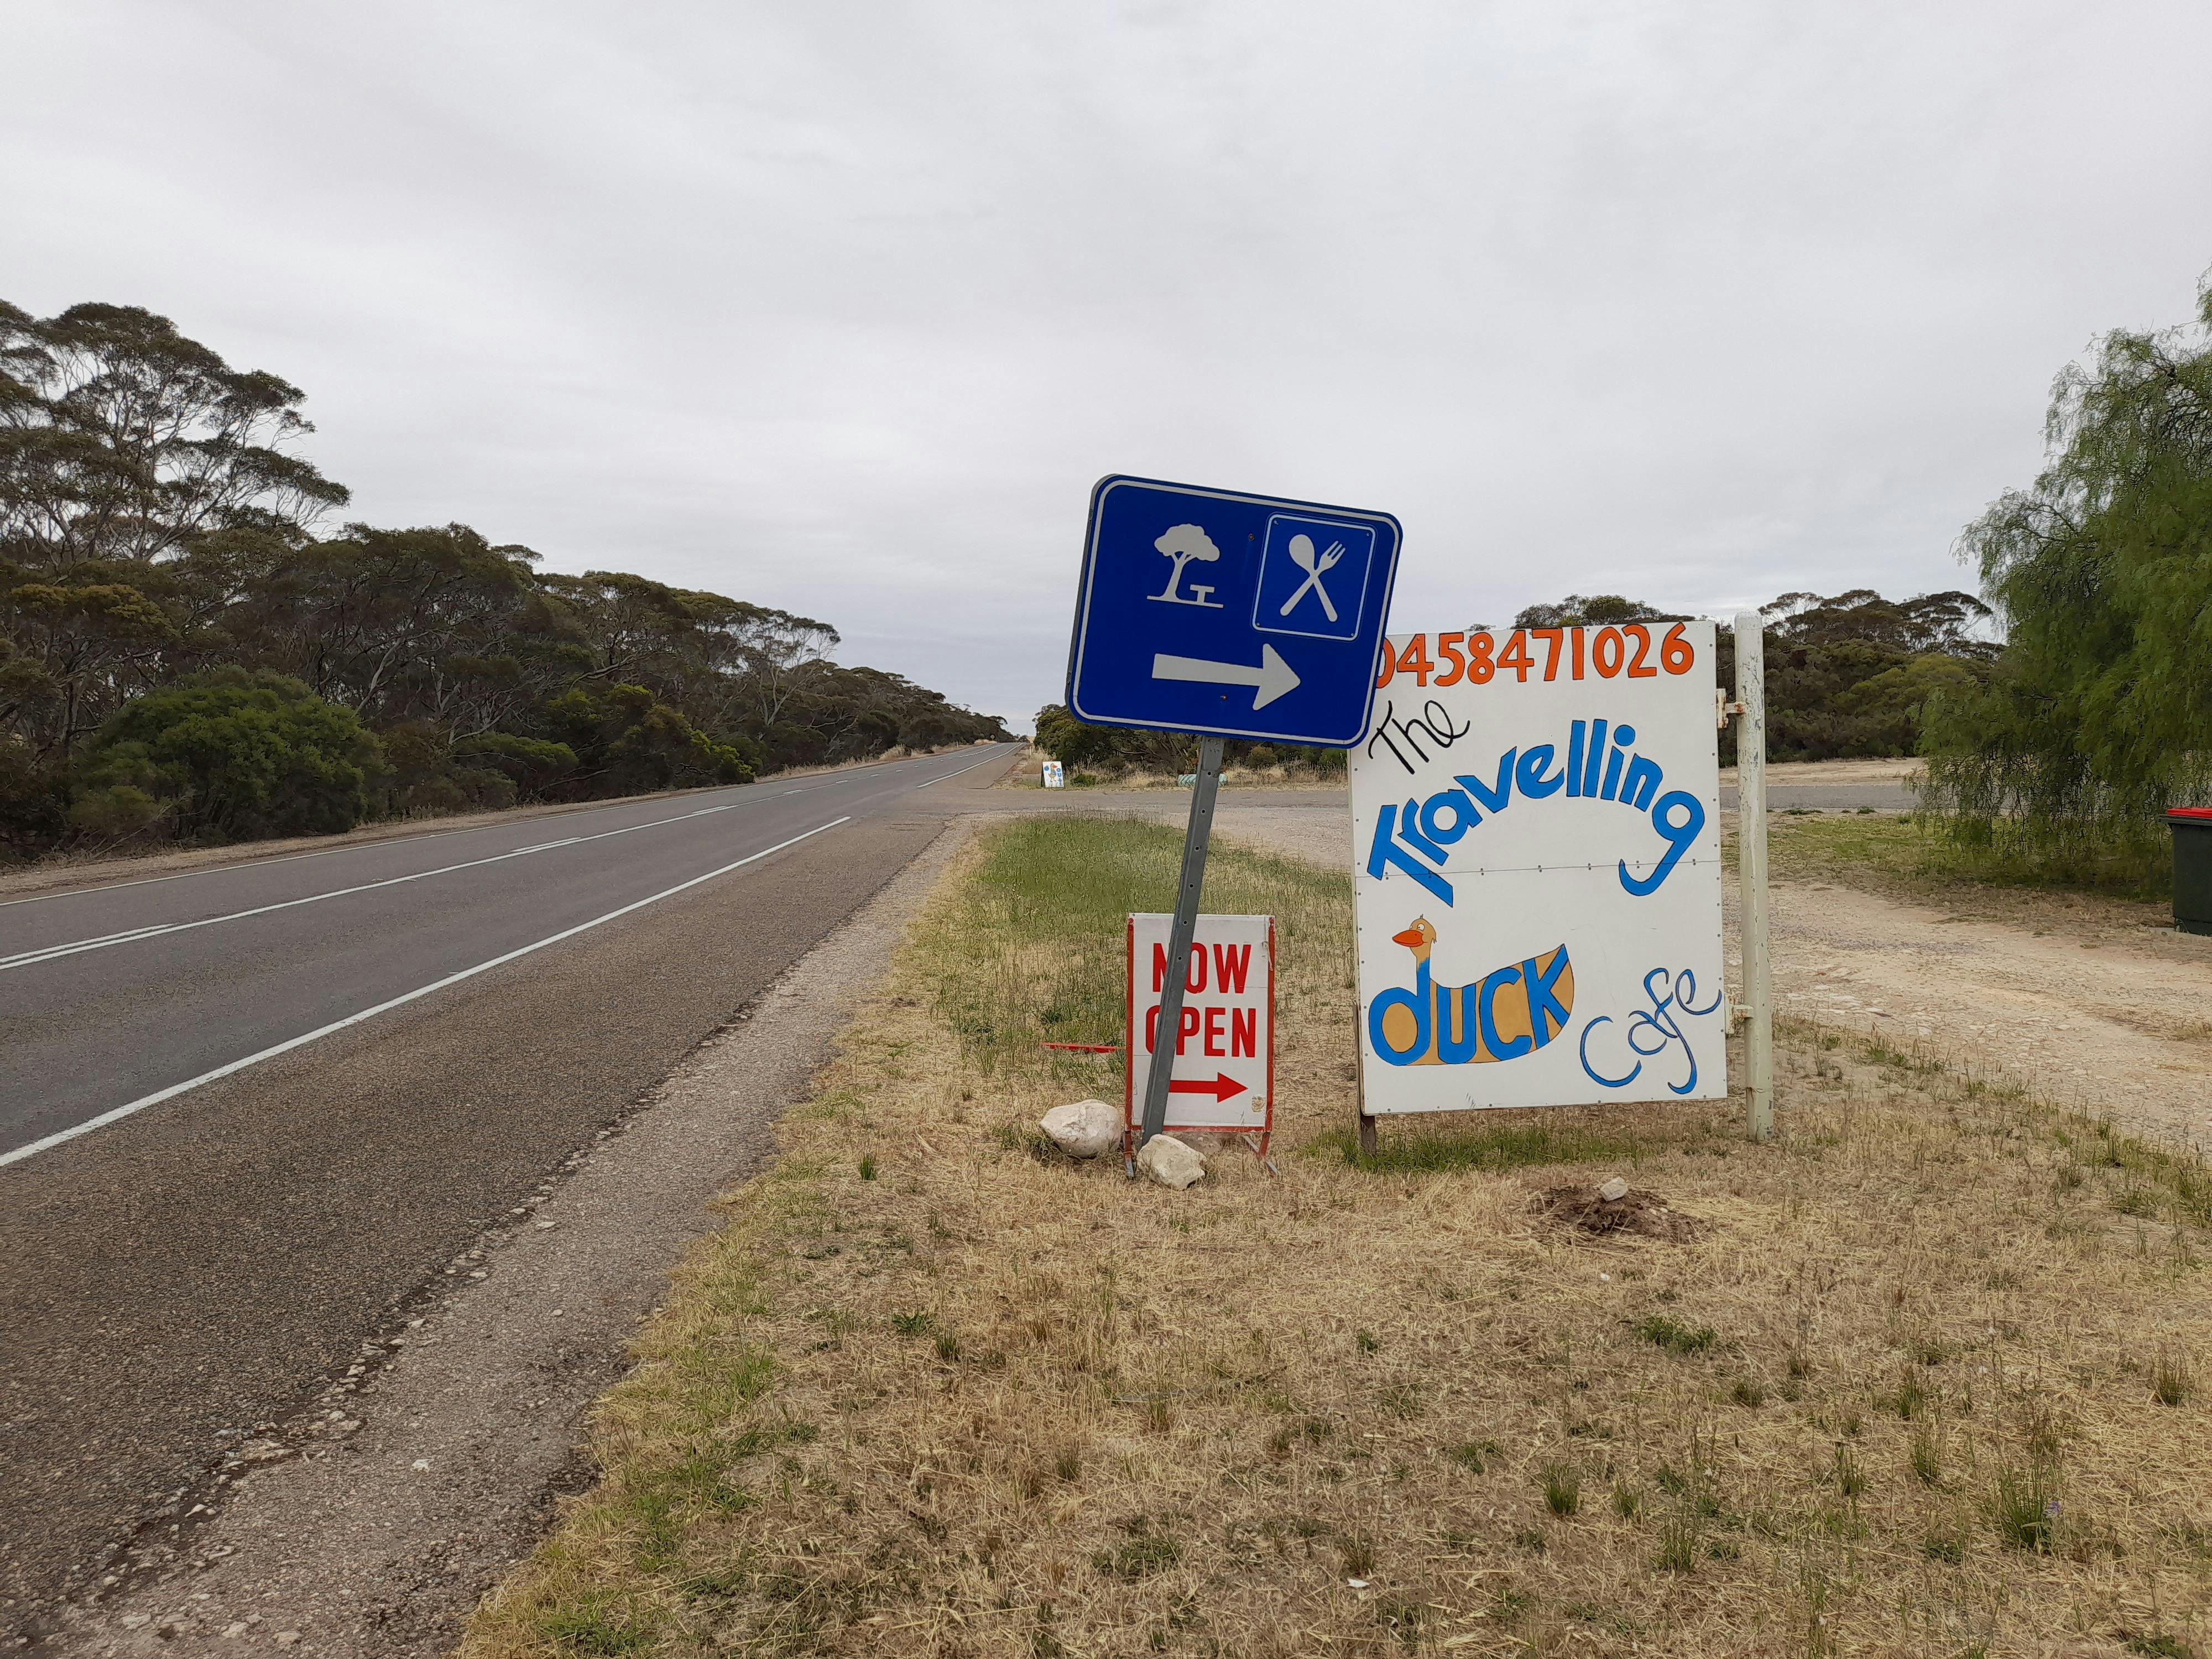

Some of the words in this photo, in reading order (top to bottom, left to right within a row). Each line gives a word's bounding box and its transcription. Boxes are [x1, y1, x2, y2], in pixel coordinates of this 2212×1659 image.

[1368, 700, 1470, 774] The
[1367, 719, 1705, 907] Travelling
[1152, 942, 1252, 994] NOW
[1145, 1004, 1257, 1058] OPEN
[1580, 967, 1722, 1095] Cafe
